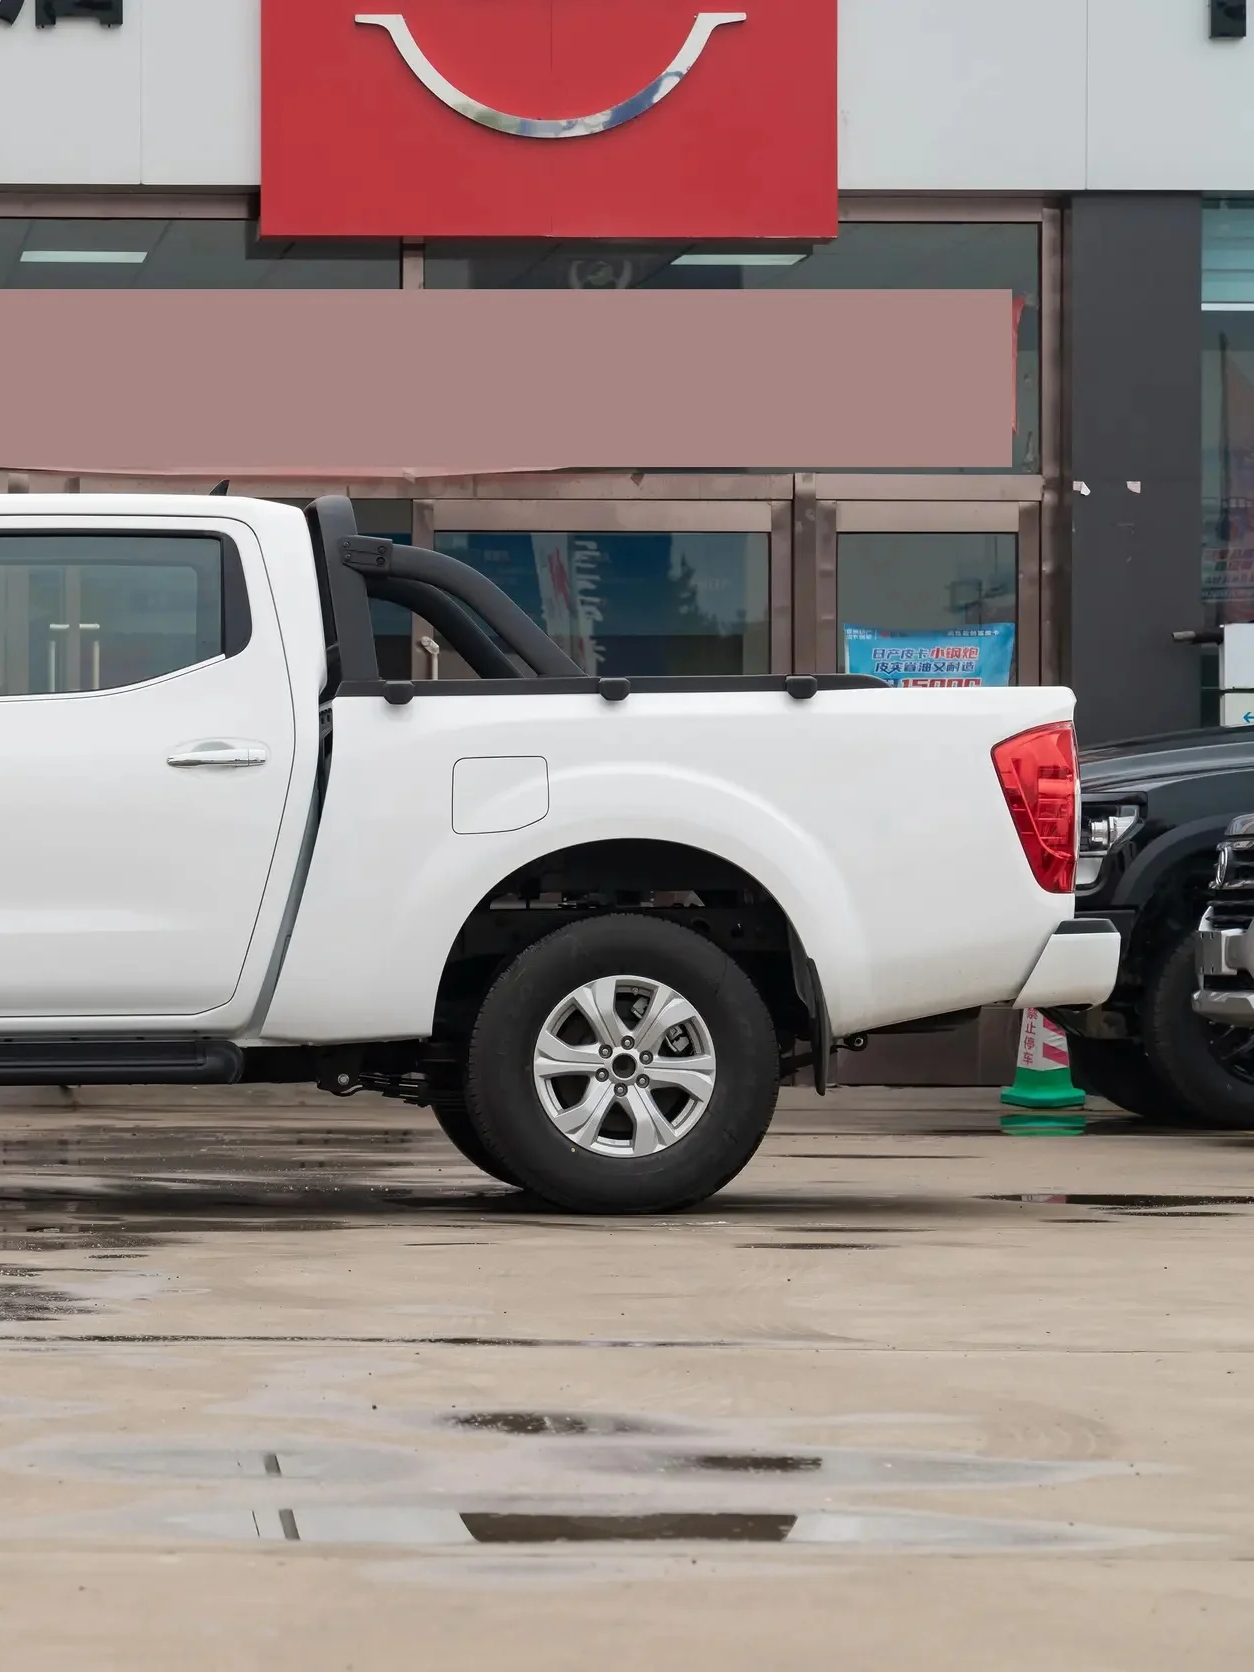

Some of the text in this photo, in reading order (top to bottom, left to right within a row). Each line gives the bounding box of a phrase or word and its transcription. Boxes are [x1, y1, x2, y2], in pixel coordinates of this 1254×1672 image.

[872, 646, 979, 660] 日产皮卡小钢炮
[875, 661, 975, 674] 皮实省油又耐造
